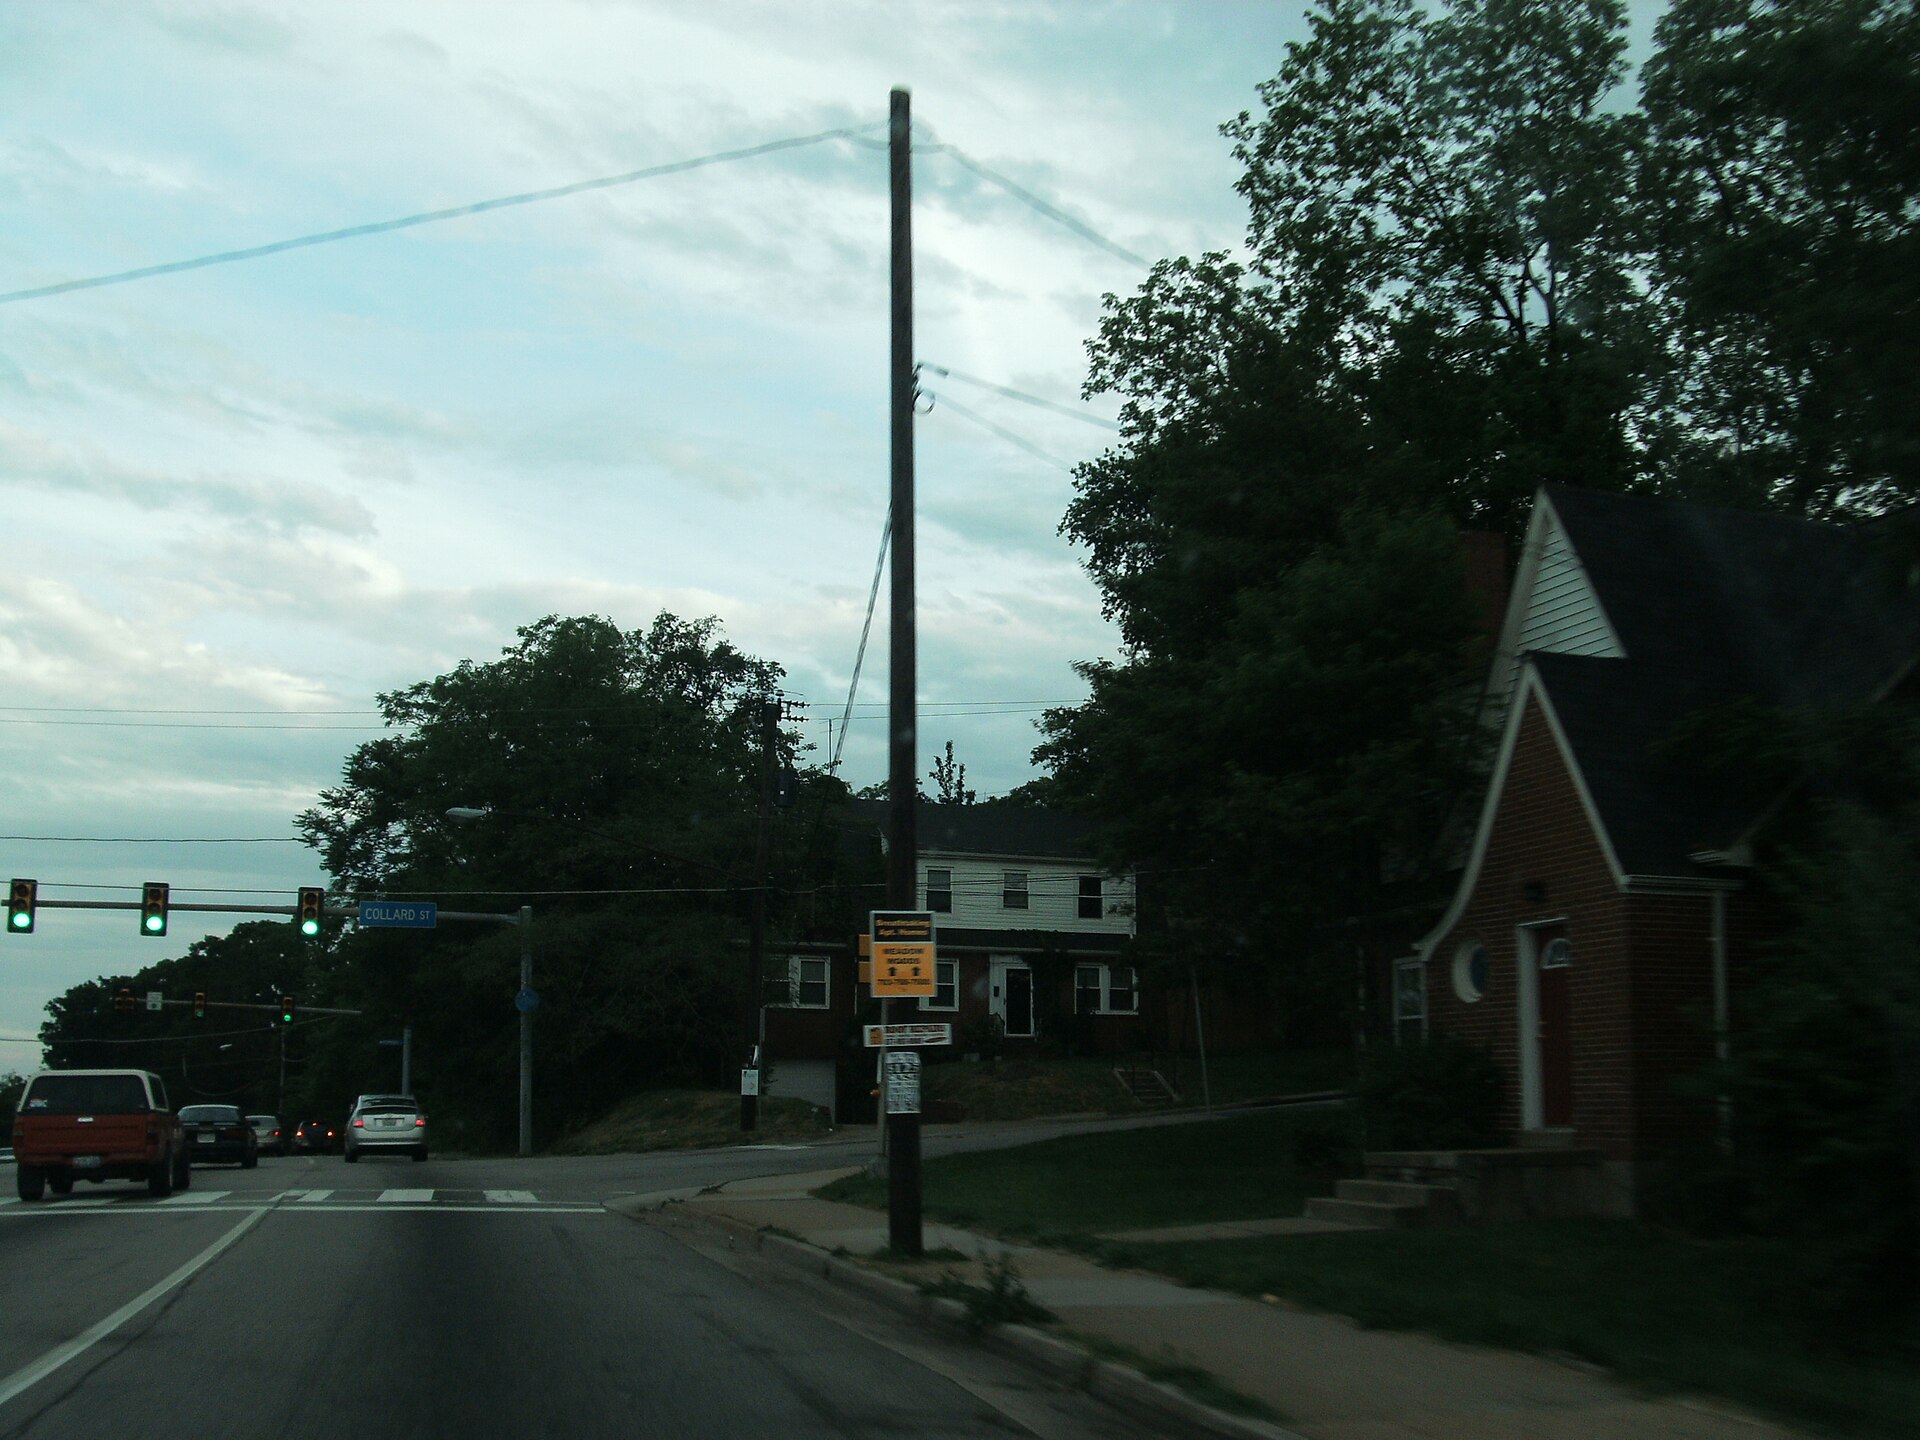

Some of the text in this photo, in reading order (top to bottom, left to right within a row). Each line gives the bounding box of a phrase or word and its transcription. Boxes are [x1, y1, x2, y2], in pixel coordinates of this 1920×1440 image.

[365, 908, 430, 921] COLLARD ST
[882, 947, 925, 955] MEADOW
[887, 957, 922, 965] WOODS
